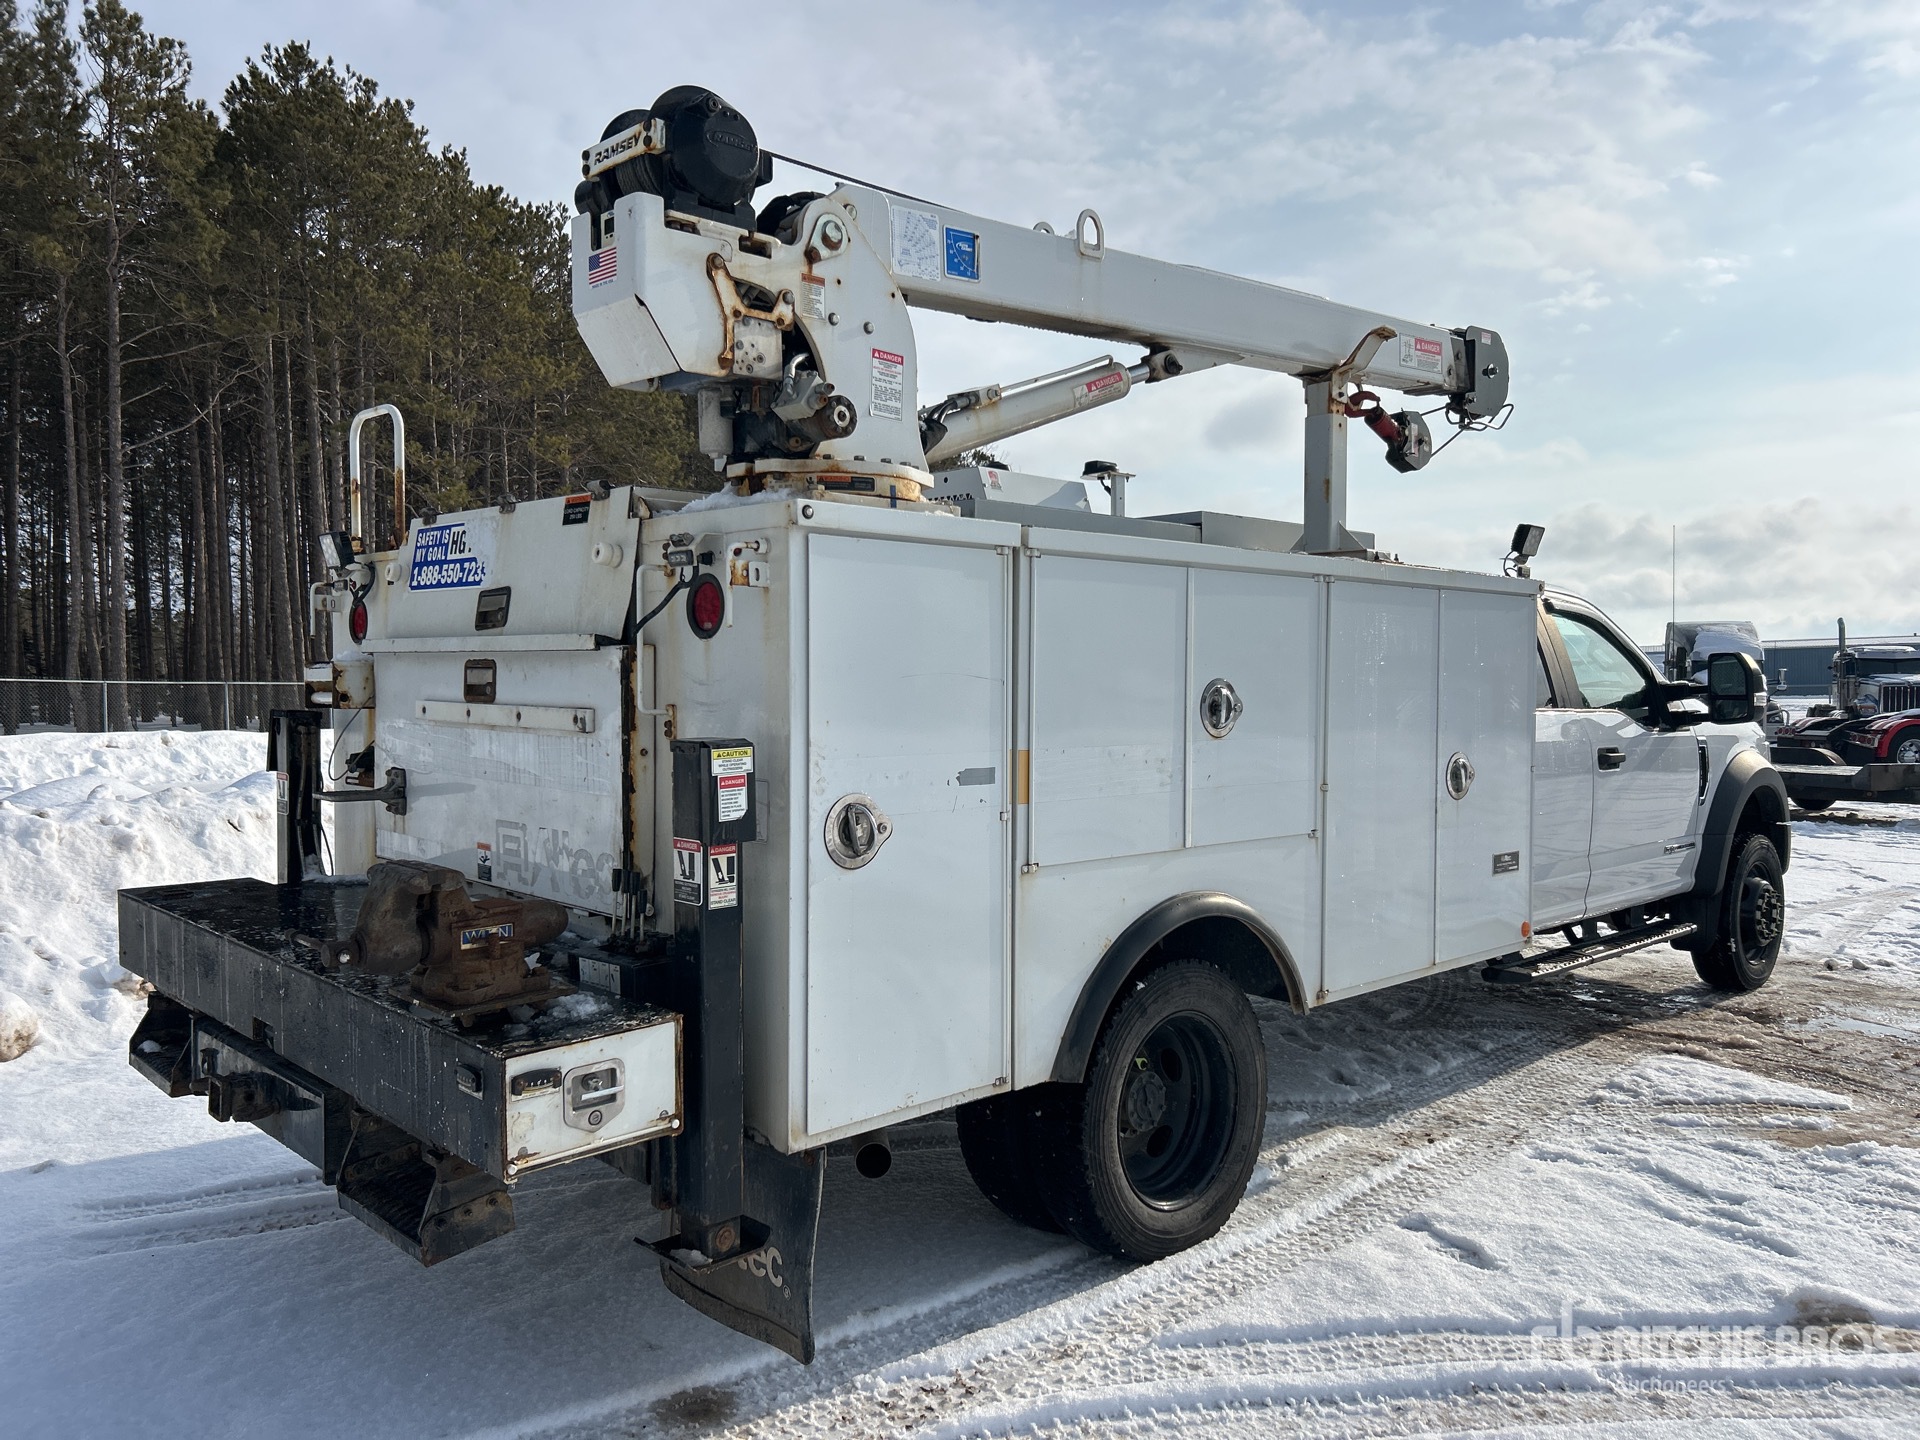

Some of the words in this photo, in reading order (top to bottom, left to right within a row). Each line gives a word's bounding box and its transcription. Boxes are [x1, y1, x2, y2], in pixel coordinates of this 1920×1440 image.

[593, 133, 641, 166] RAMSEY
[1421, 343, 1440, 353] DANGER
[880, 352, 902, 364] DANGER
[1096, 374, 1120, 388] DANGER
[416, 530, 442, 547] SAFETY
[441, 529, 449, 544] IS
[415, 547, 426, 562] MY
[427, 546, 446, 561] GOAL
[722, 750, 748, 758] CAUTION
[724, 778, 745, 786] DANGER
[681, 841, 698, 850] DANGER
[715, 845, 736, 853] DANGER
